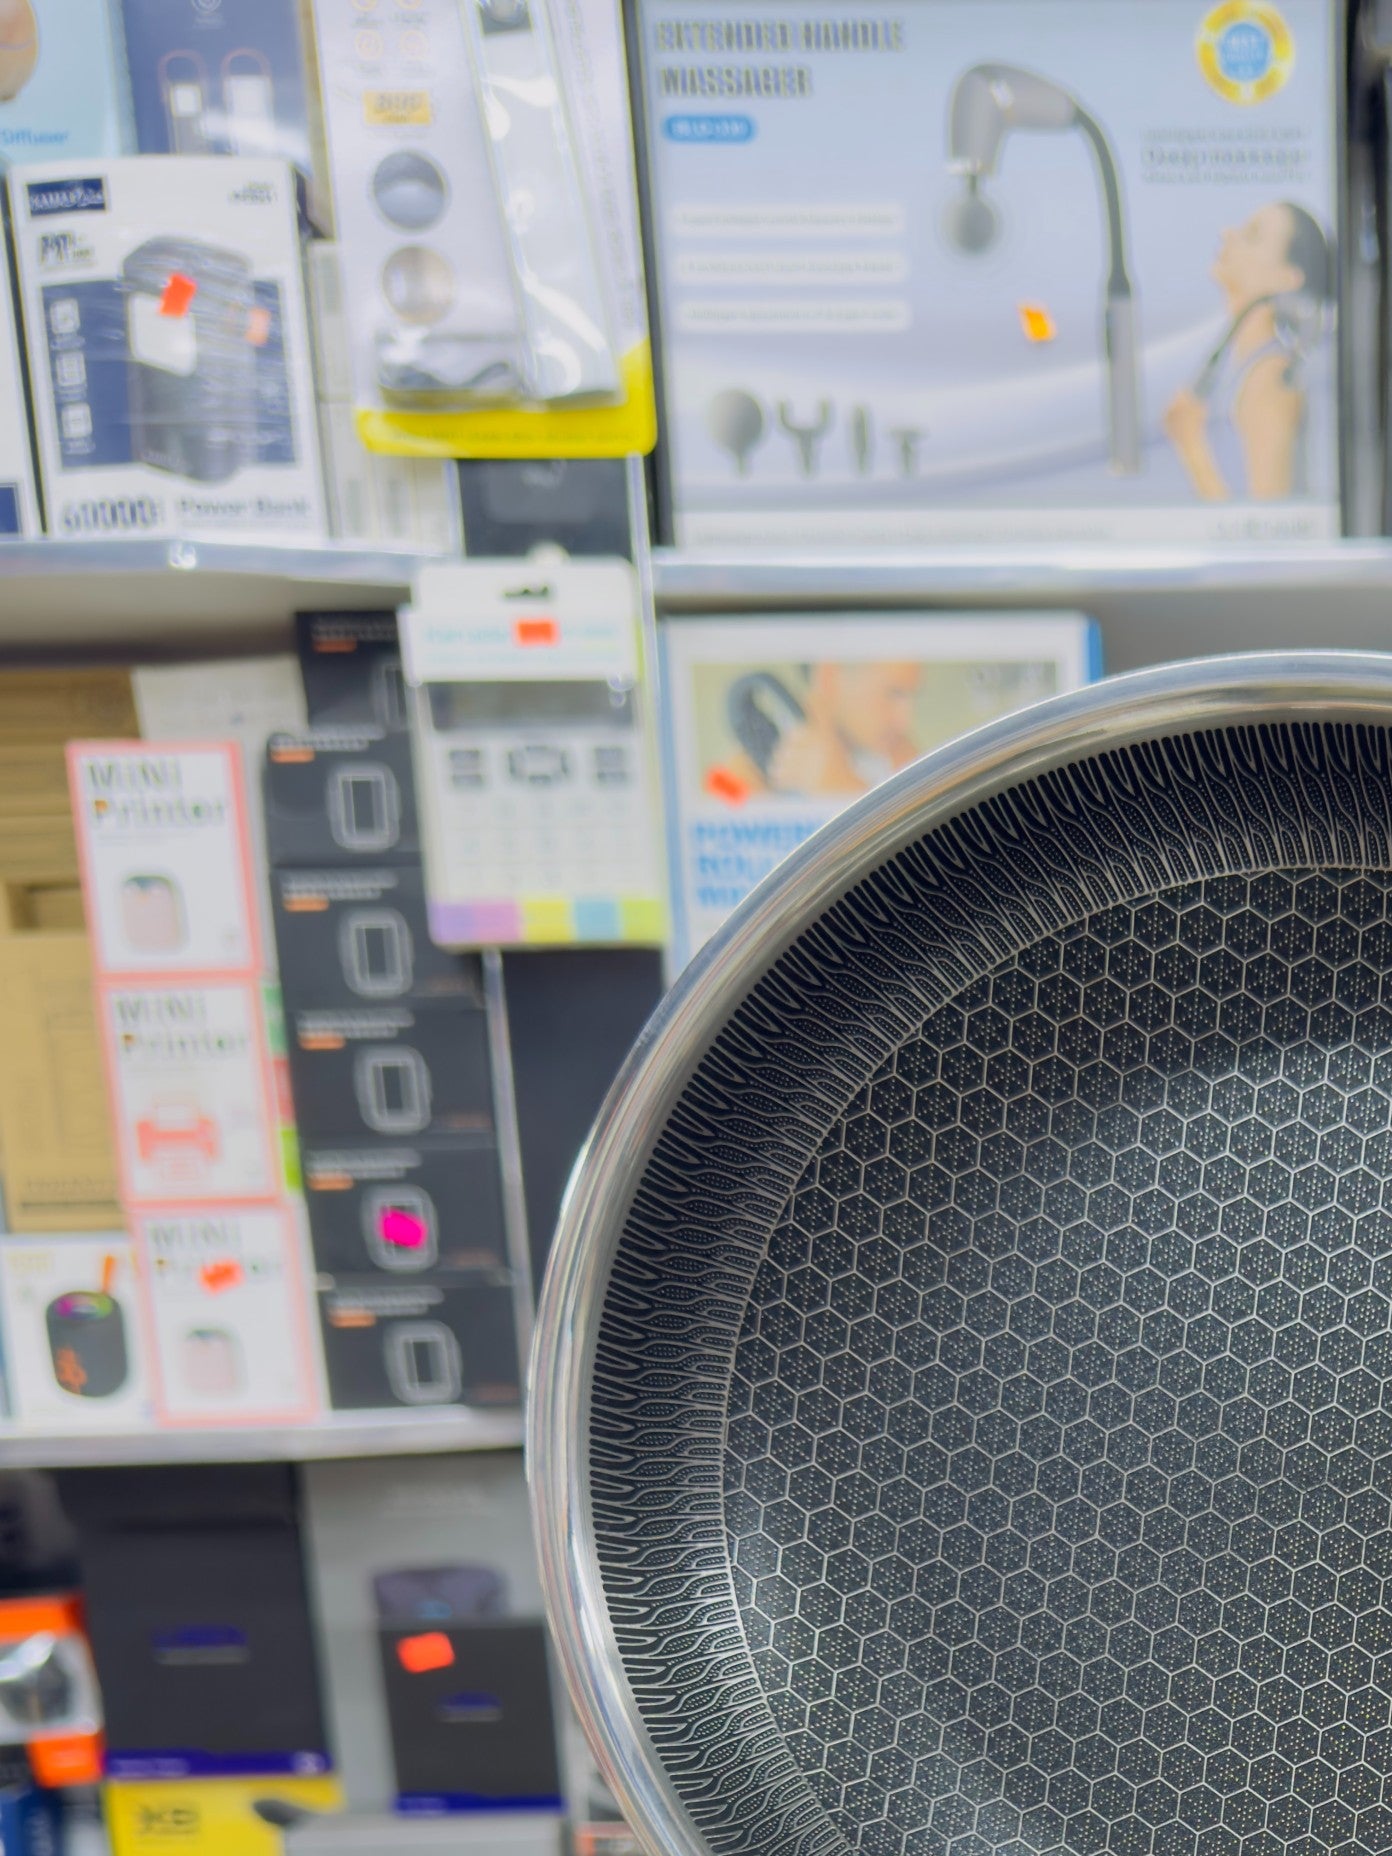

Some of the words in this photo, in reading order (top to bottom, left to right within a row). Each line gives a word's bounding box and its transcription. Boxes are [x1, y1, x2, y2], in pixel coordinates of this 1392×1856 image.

[657, 19, 792, 51] EXTENDED
[800, 19, 906, 51] HANDLE
[659, 66, 813, 97] MASSAGER
